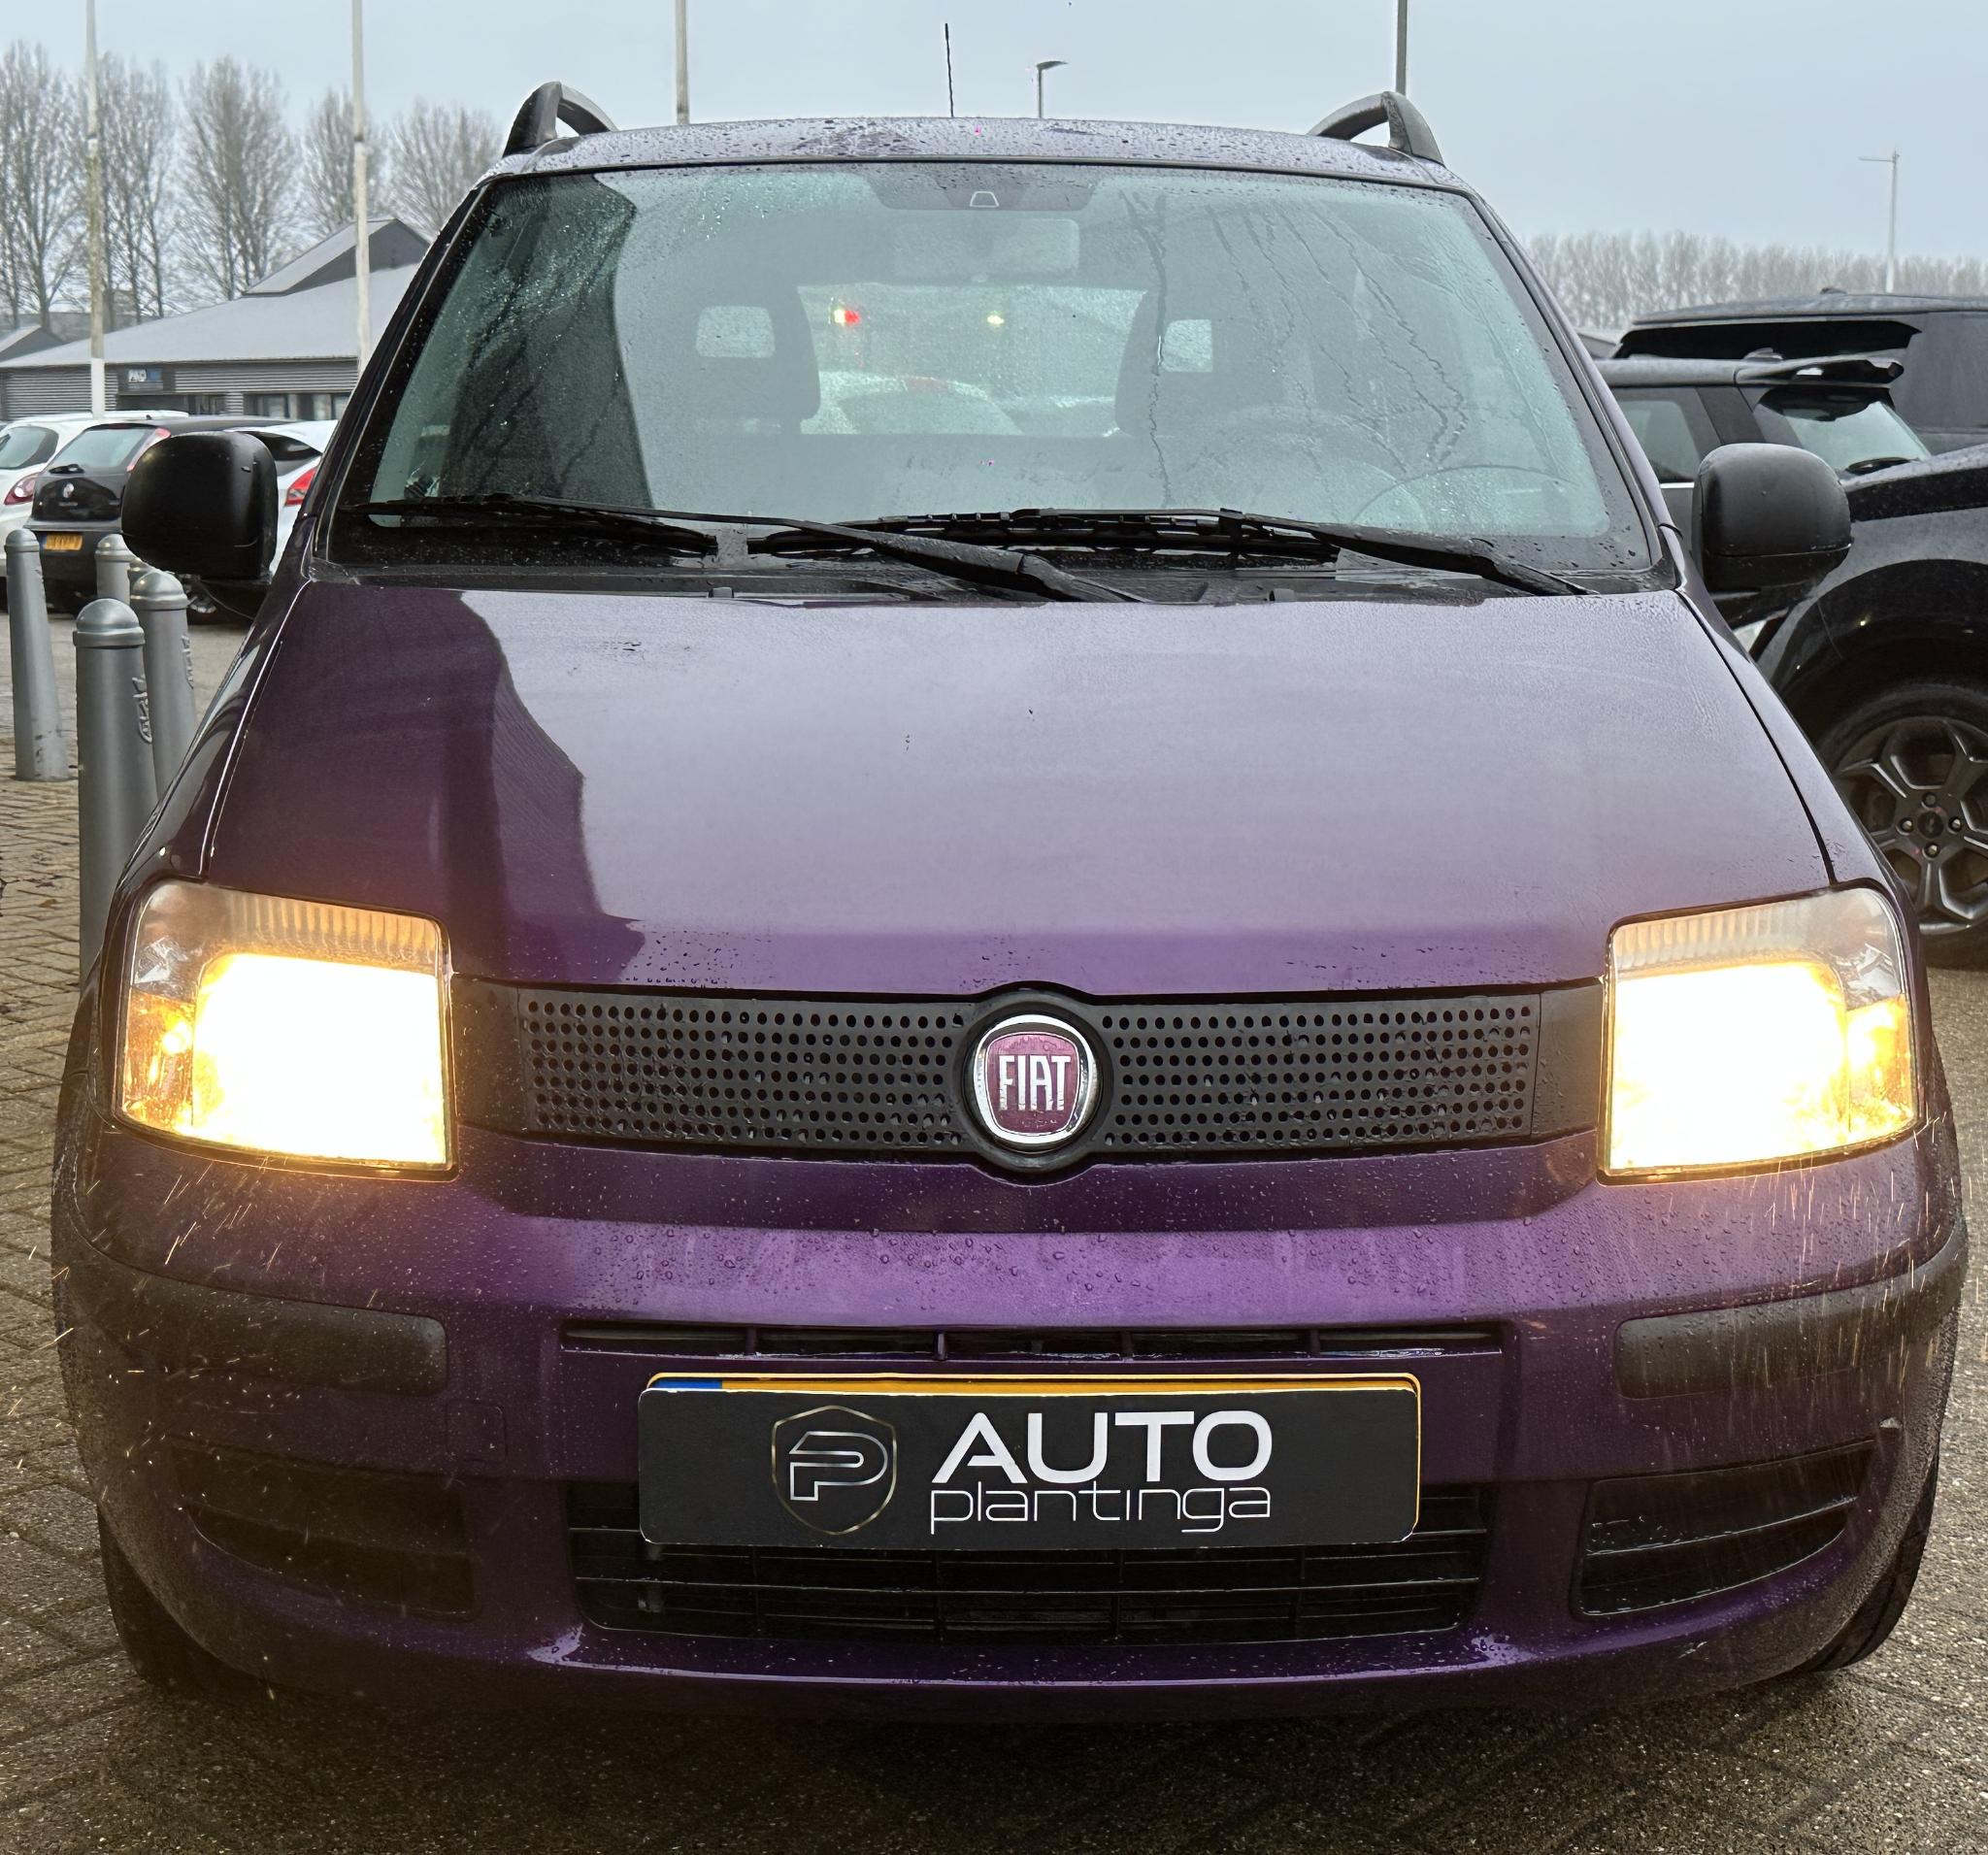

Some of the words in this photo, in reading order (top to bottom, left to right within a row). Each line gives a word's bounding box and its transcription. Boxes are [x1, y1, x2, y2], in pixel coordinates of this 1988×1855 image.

[999, 1055, 1072, 1111] FIAT
[931, 1410, 1273, 1483] AUTO
[930, 1481, 1272, 1535] plantinga
